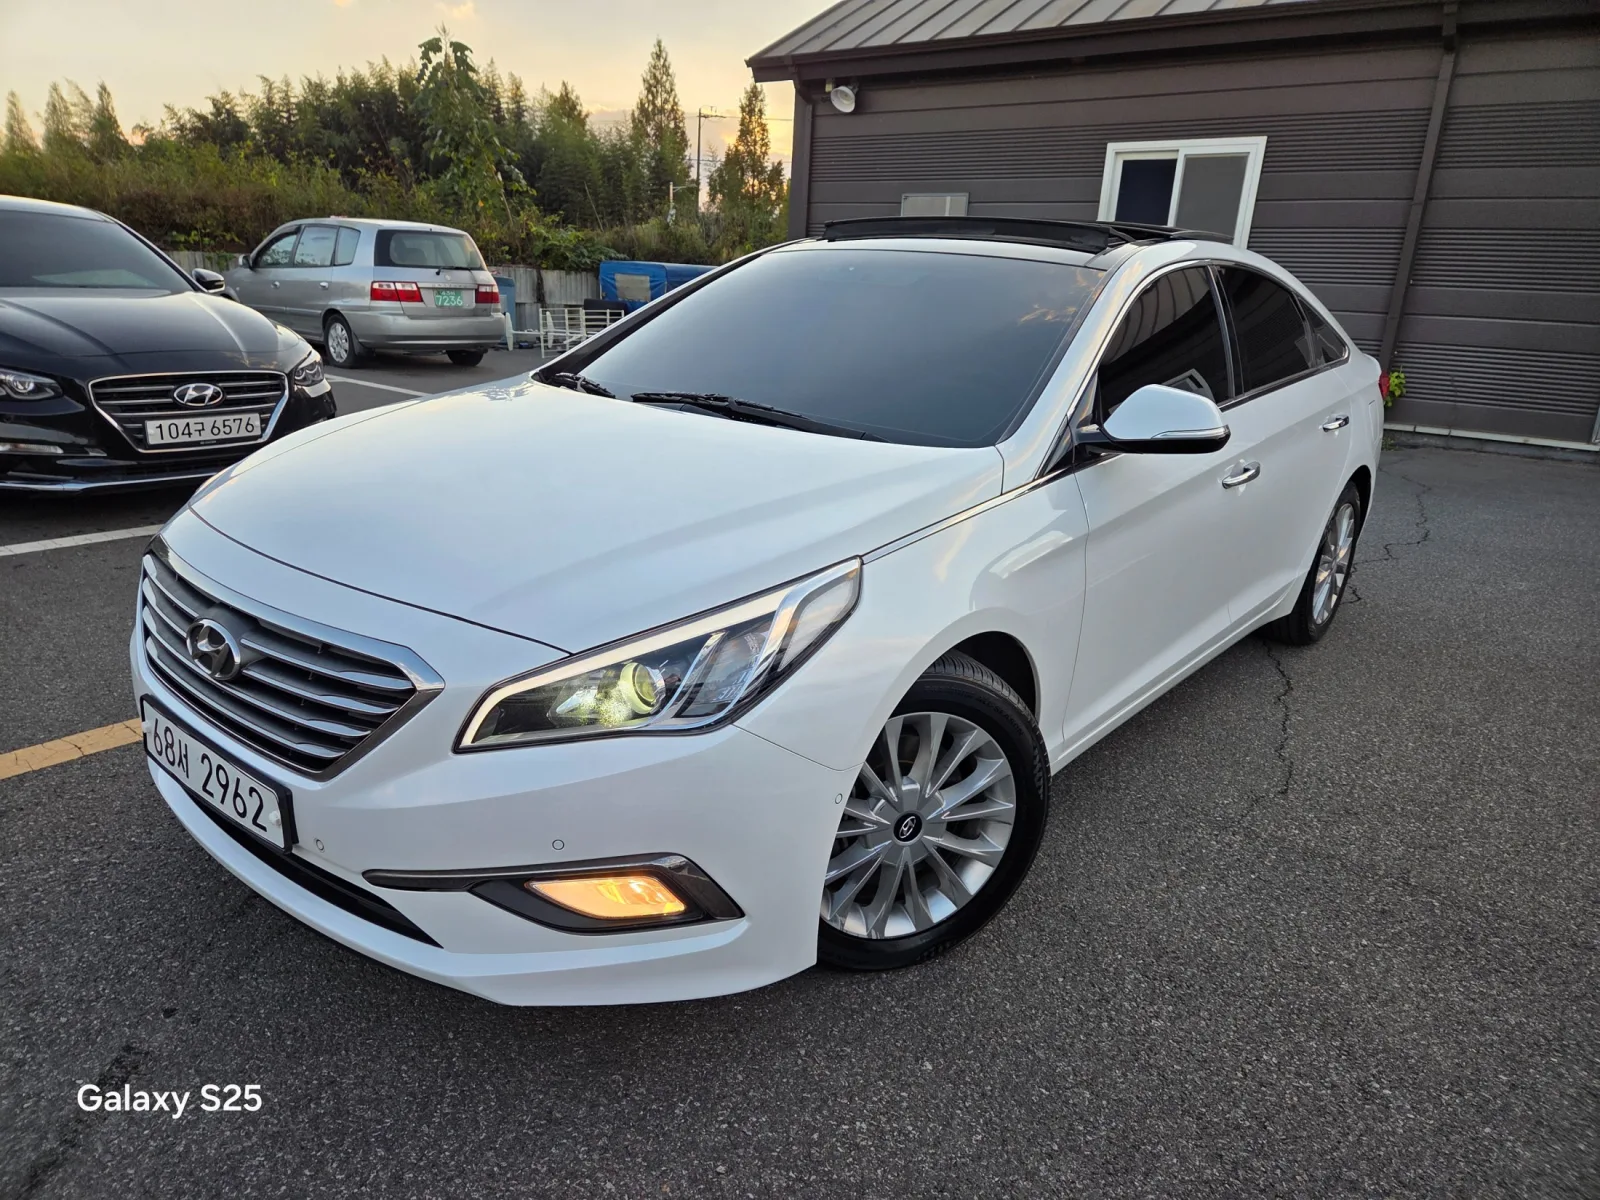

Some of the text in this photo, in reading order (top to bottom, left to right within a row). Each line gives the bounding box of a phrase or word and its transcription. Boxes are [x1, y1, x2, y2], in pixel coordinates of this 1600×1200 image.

[435, 295, 463, 306] 7236
[155, 417, 255, 440] 104구 6576
[153, 718, 268, 833] 68서 2962
